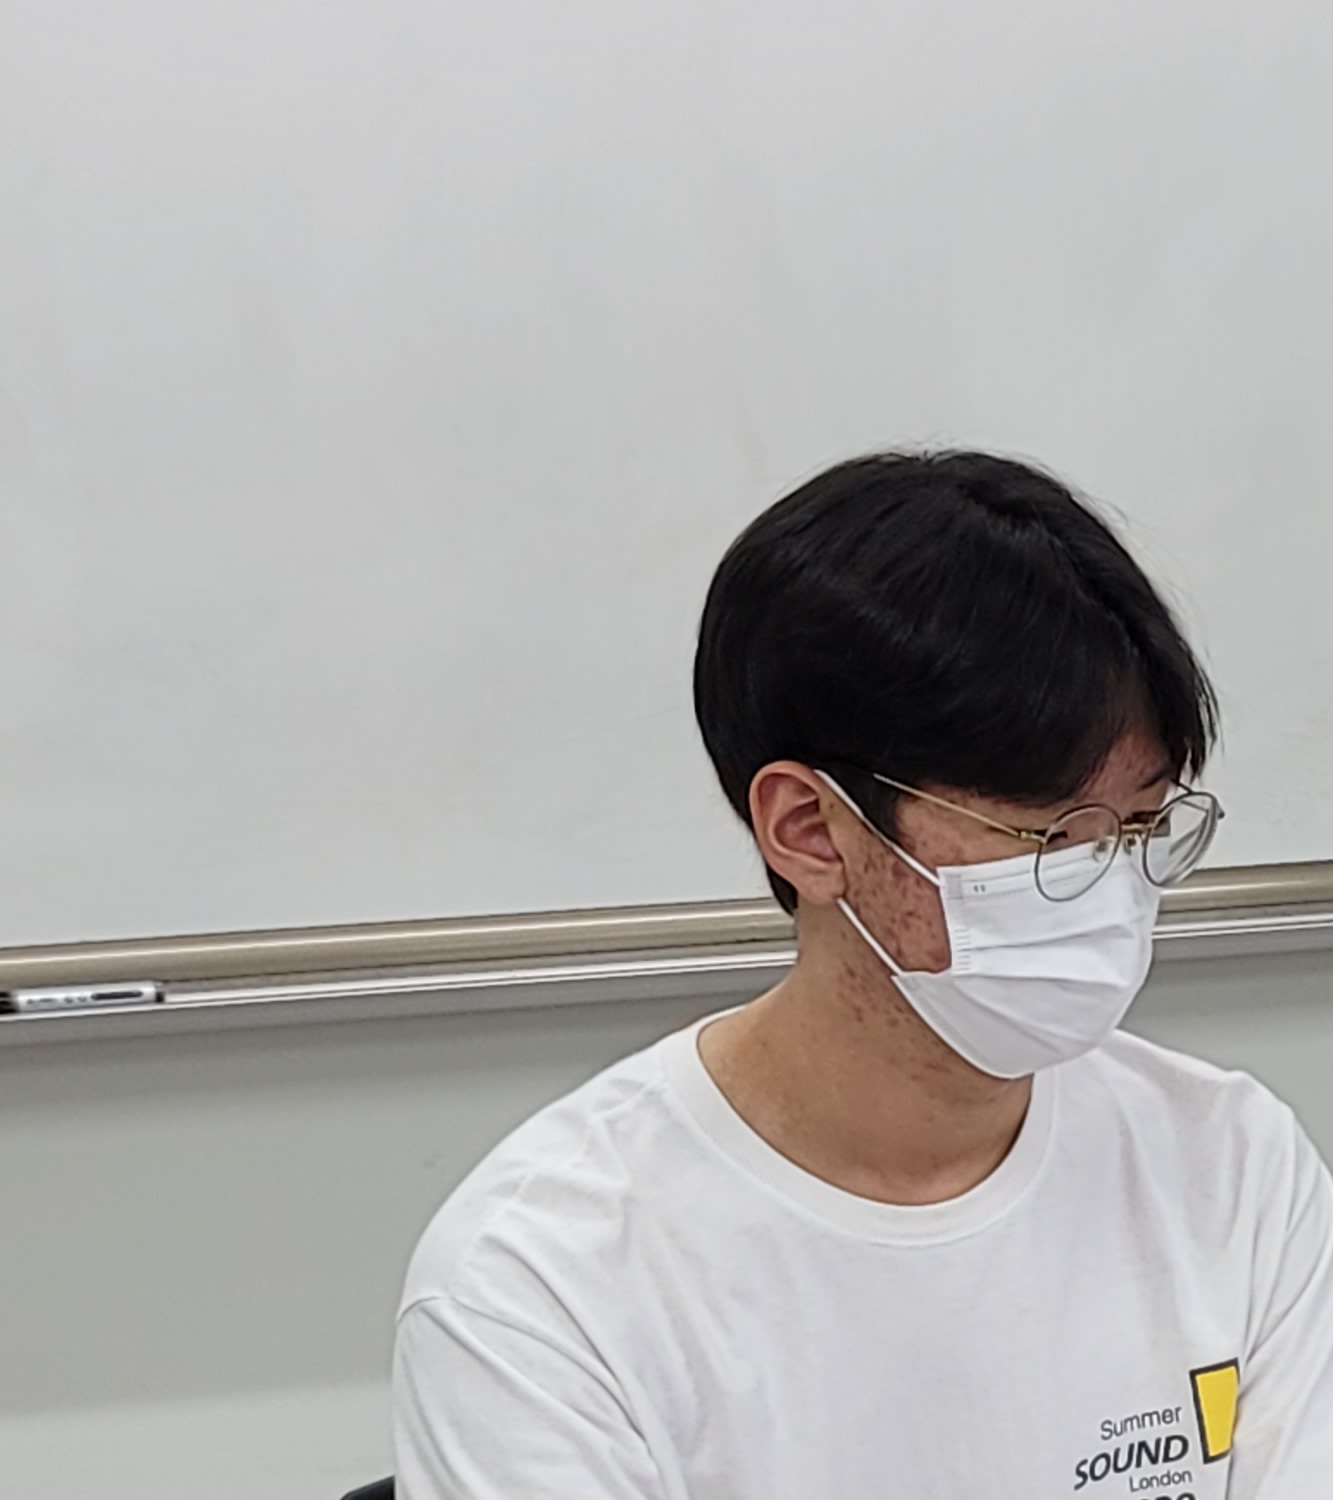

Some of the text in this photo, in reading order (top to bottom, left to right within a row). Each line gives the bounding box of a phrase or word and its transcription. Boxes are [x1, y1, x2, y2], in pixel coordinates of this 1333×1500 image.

[1100, 1405, 1183, 1441] Summer
[1073, 1433, 1190, 1491] SOUND
[1128, 1469, 1193, 1493] London
